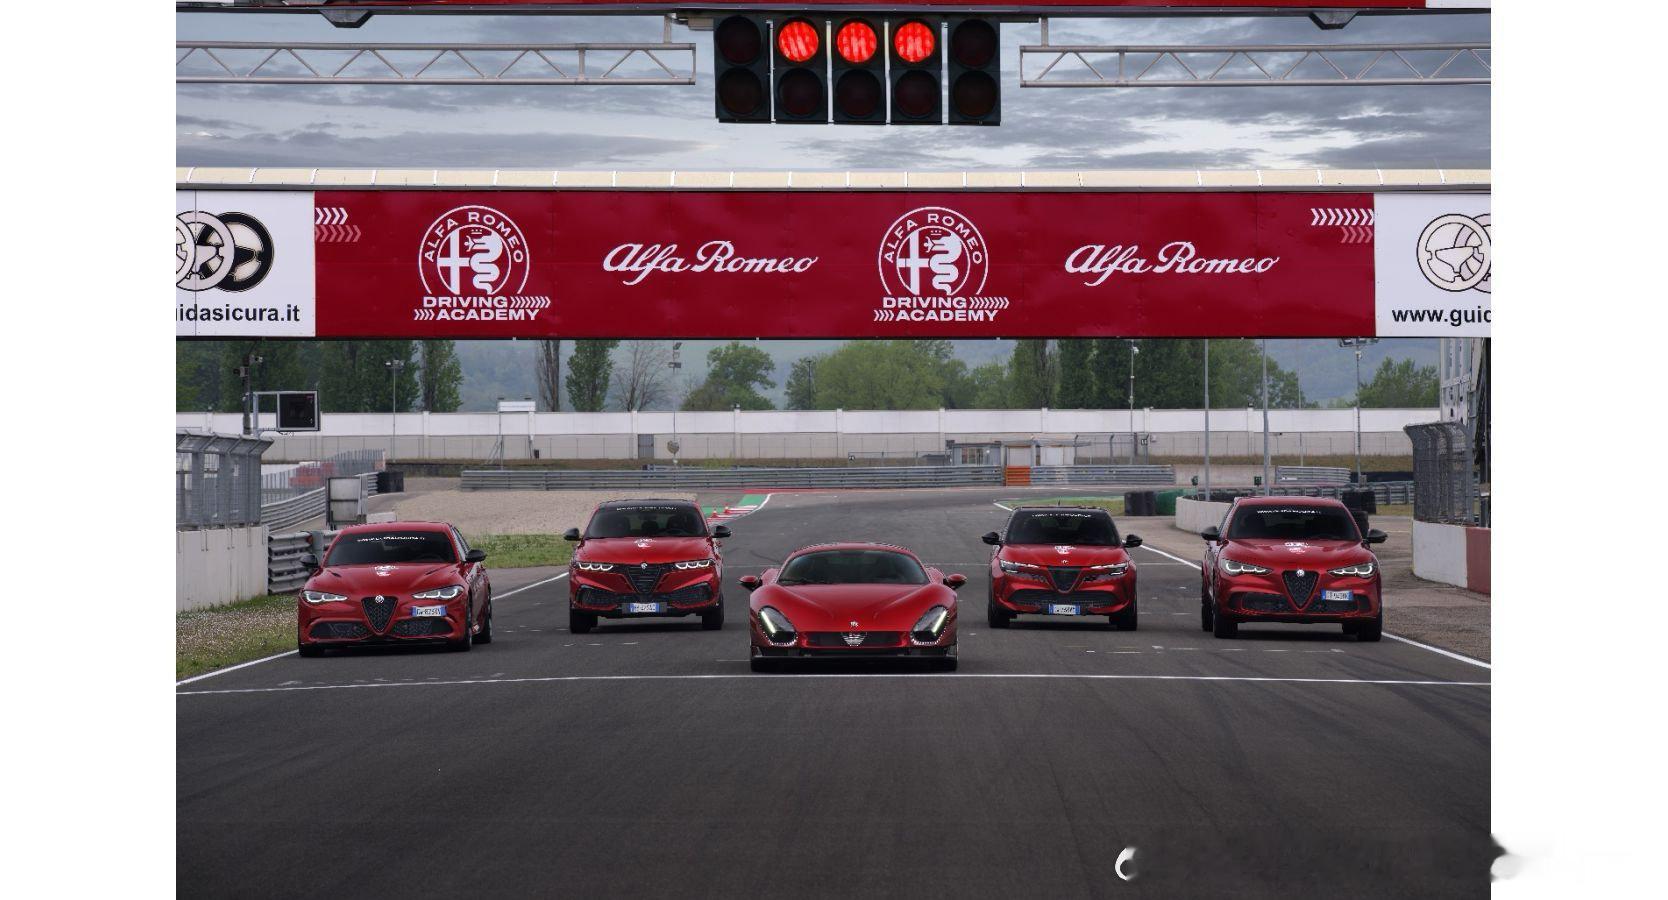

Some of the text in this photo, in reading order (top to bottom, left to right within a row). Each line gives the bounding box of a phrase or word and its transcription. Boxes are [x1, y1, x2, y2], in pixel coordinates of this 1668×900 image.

[424, 211, 524, 263] ALFA ROMEO
[884, 213, 983, 265] ALFA ROMEO
[603, 240, 819, 286] Alfa Romeo
[1064, 241, 1280, 287] Alfa Romeo
[423, 296, 508, 308] DRIVING
[882, 296, 967, 309] DRIVING
[176, 303, 300, 321] idasicura.it
[435, 308, 540, 320] ACADEMY
[895, 309, 999, 321] ACADEMY
